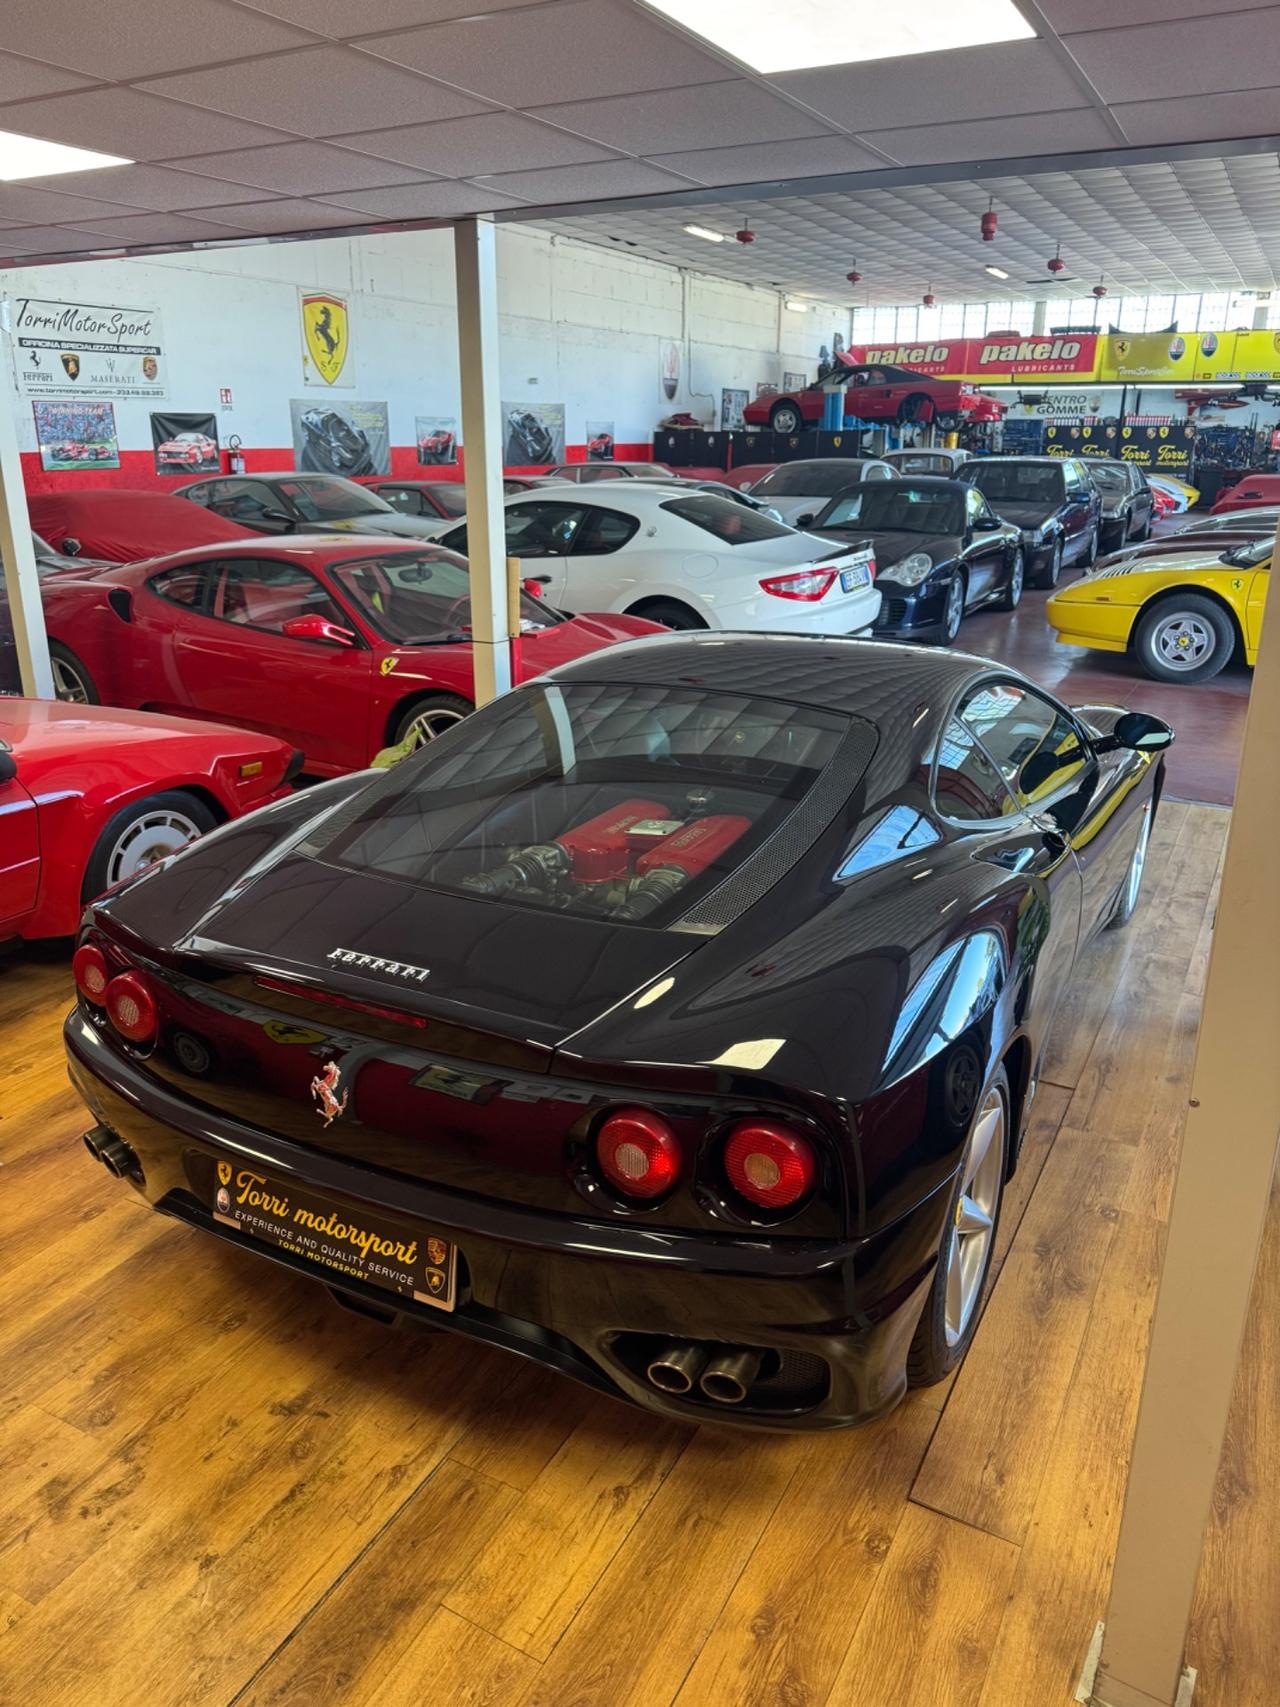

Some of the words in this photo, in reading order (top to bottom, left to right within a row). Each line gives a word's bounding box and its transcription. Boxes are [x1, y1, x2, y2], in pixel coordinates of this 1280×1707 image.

[22, 339, 60, 349] OFFICINA
[61, 342, 118, 352] SPECIALIZZATA
[979, 340, 1081, 365] pakelo
[23, 371, 53, 381] Ferrari
[1011, 363, 1075, 373] LUBRICANTS
[90, 375, 135, 384] MASERATI
[1036, 404, 1087, 415] GOMME
[1121, 444, 1150, 461] Torri
[1157, 444, 1188, 461] Torri
[327, 947, 431, 982] Ferrari
[236, 1170, 291, 1217] Torri
[293, 1207, 418, 1265] motorsport
[234, 1209, 294, 1240] EXPERIENCE
[296, 1234, 318, 1250] AND
[320, 1244, 364, 1268] QUALITY
[368, 1261, 415, 1287] SERVICE
[277, 1238, 305, 1256] TORRI
[306, 1251, 369, 1281] MOTORSPORT
